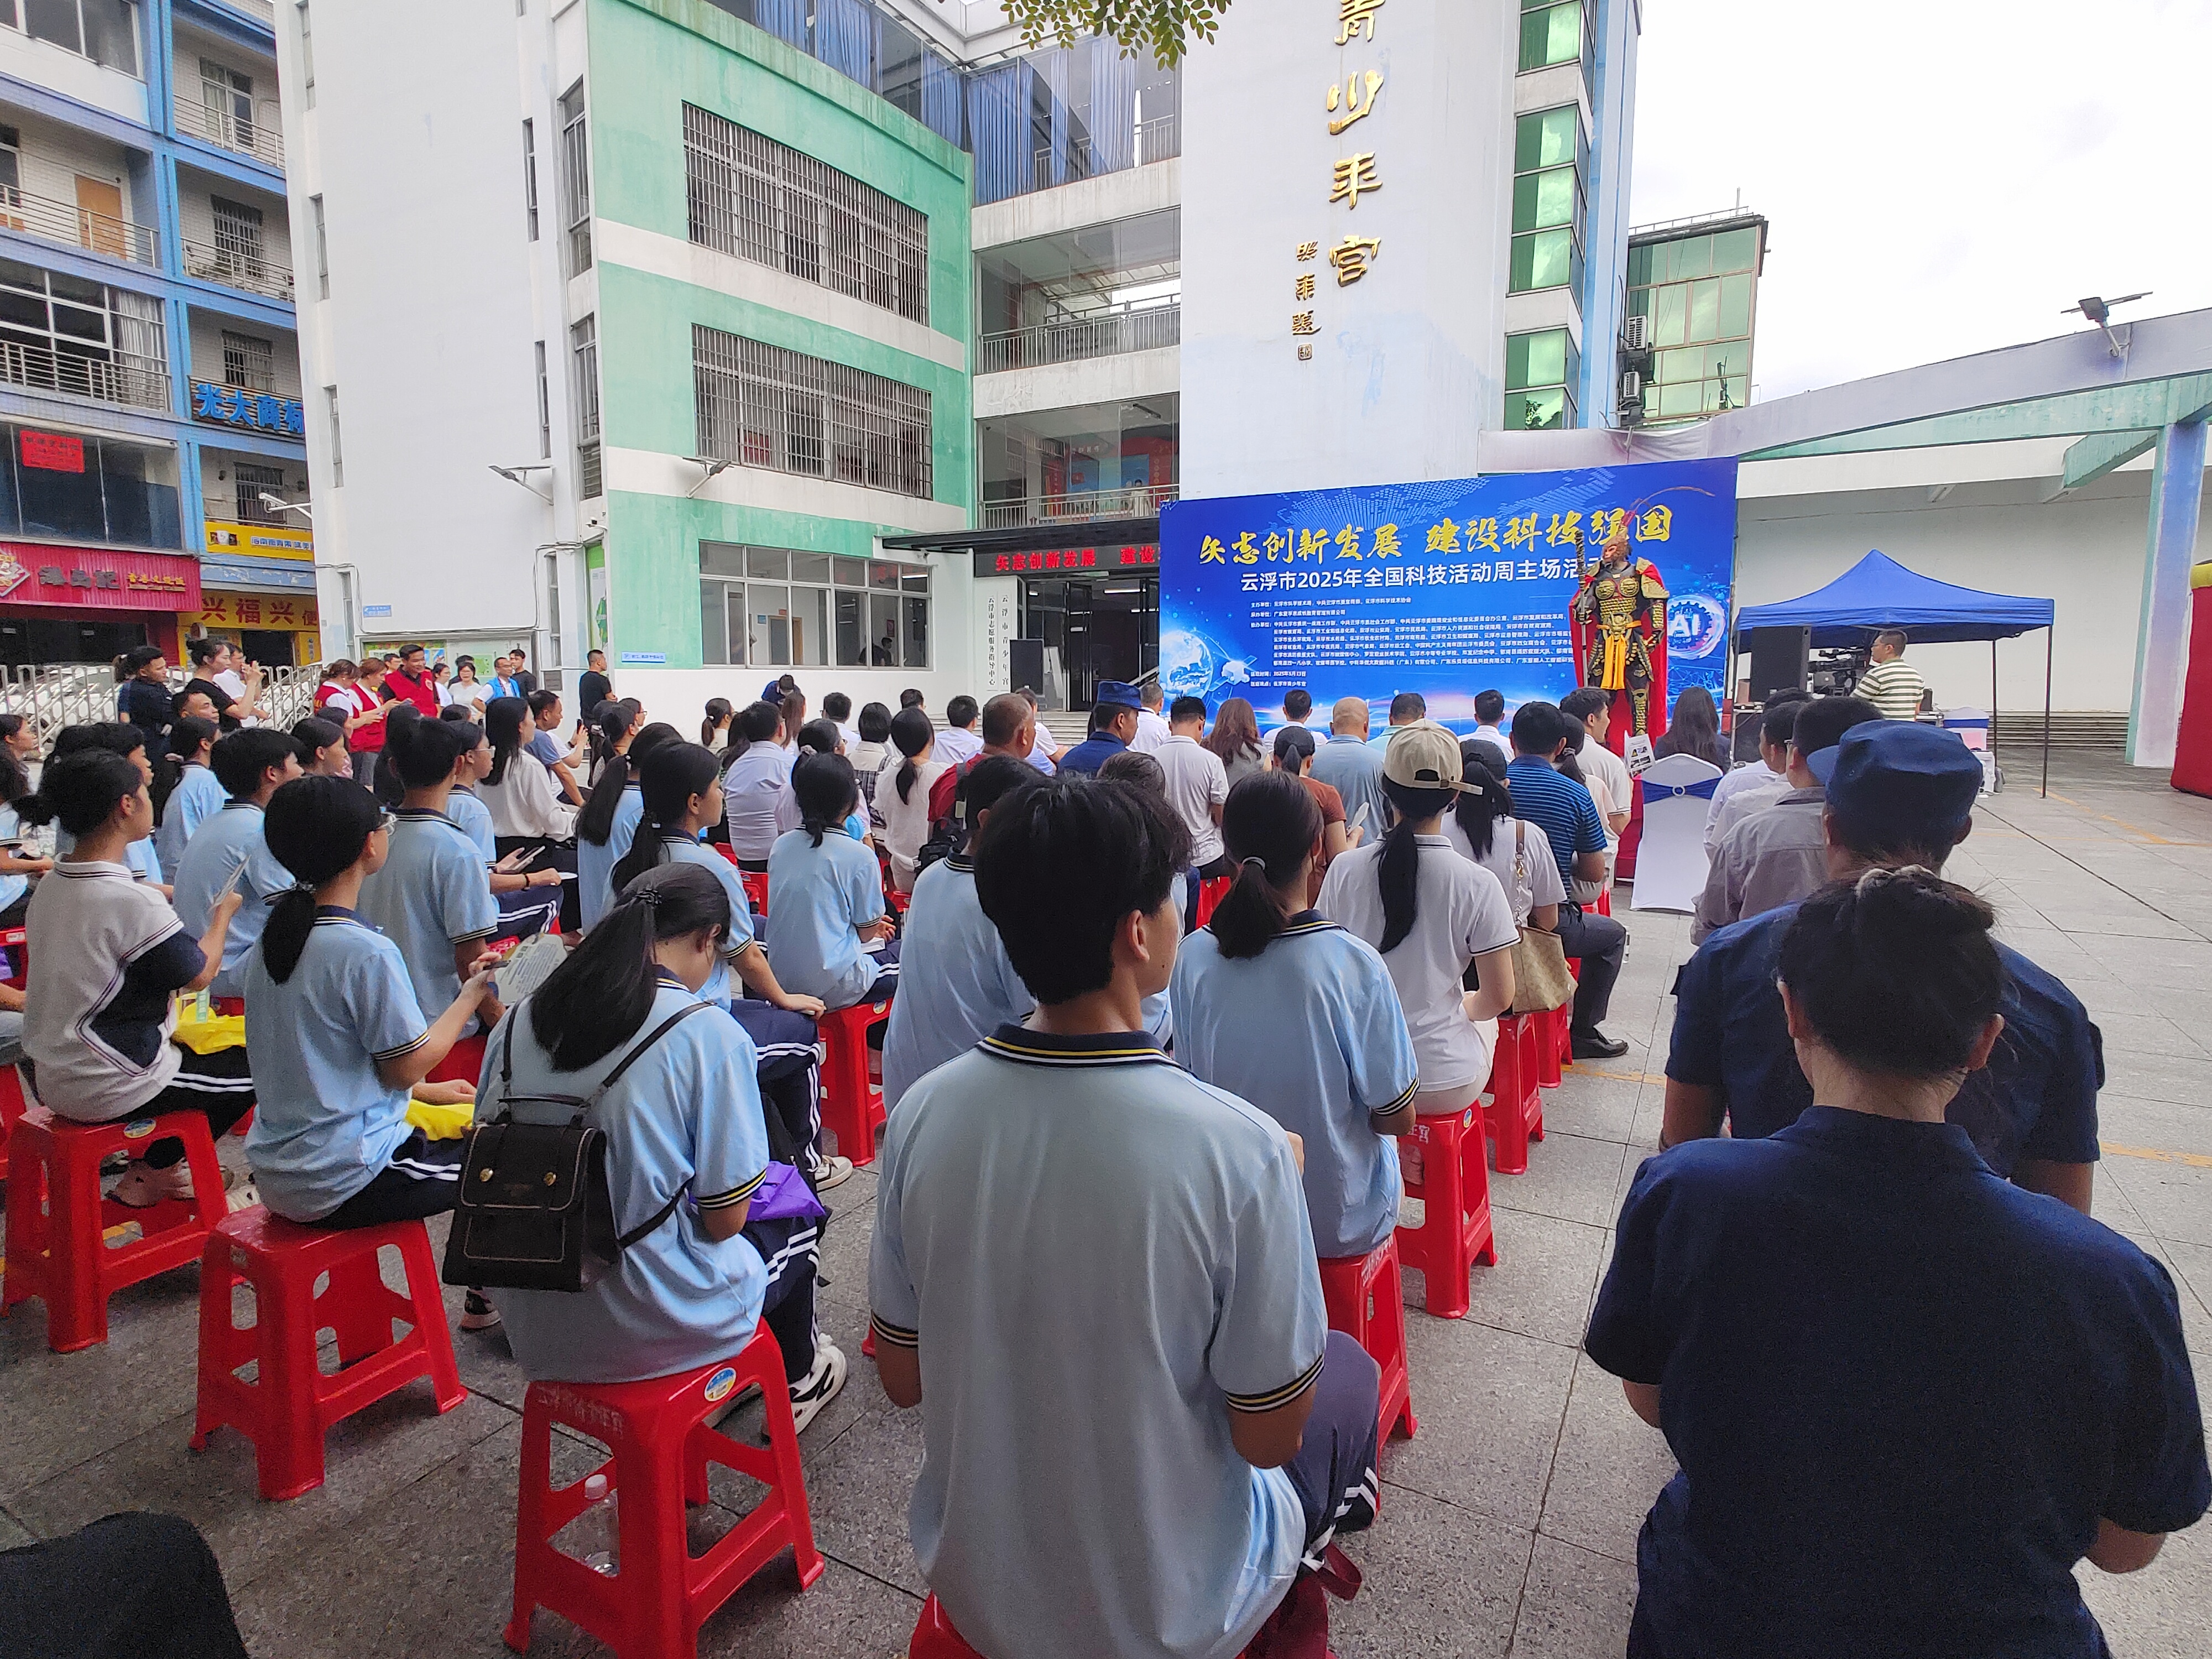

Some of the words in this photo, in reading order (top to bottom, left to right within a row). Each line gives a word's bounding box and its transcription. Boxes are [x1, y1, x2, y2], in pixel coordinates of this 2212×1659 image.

[996, 548, 1097, 572] 矢志创新发展
[1120, 545, 1160, 565] 建设
[1667, 614, 1699, 637] AI
